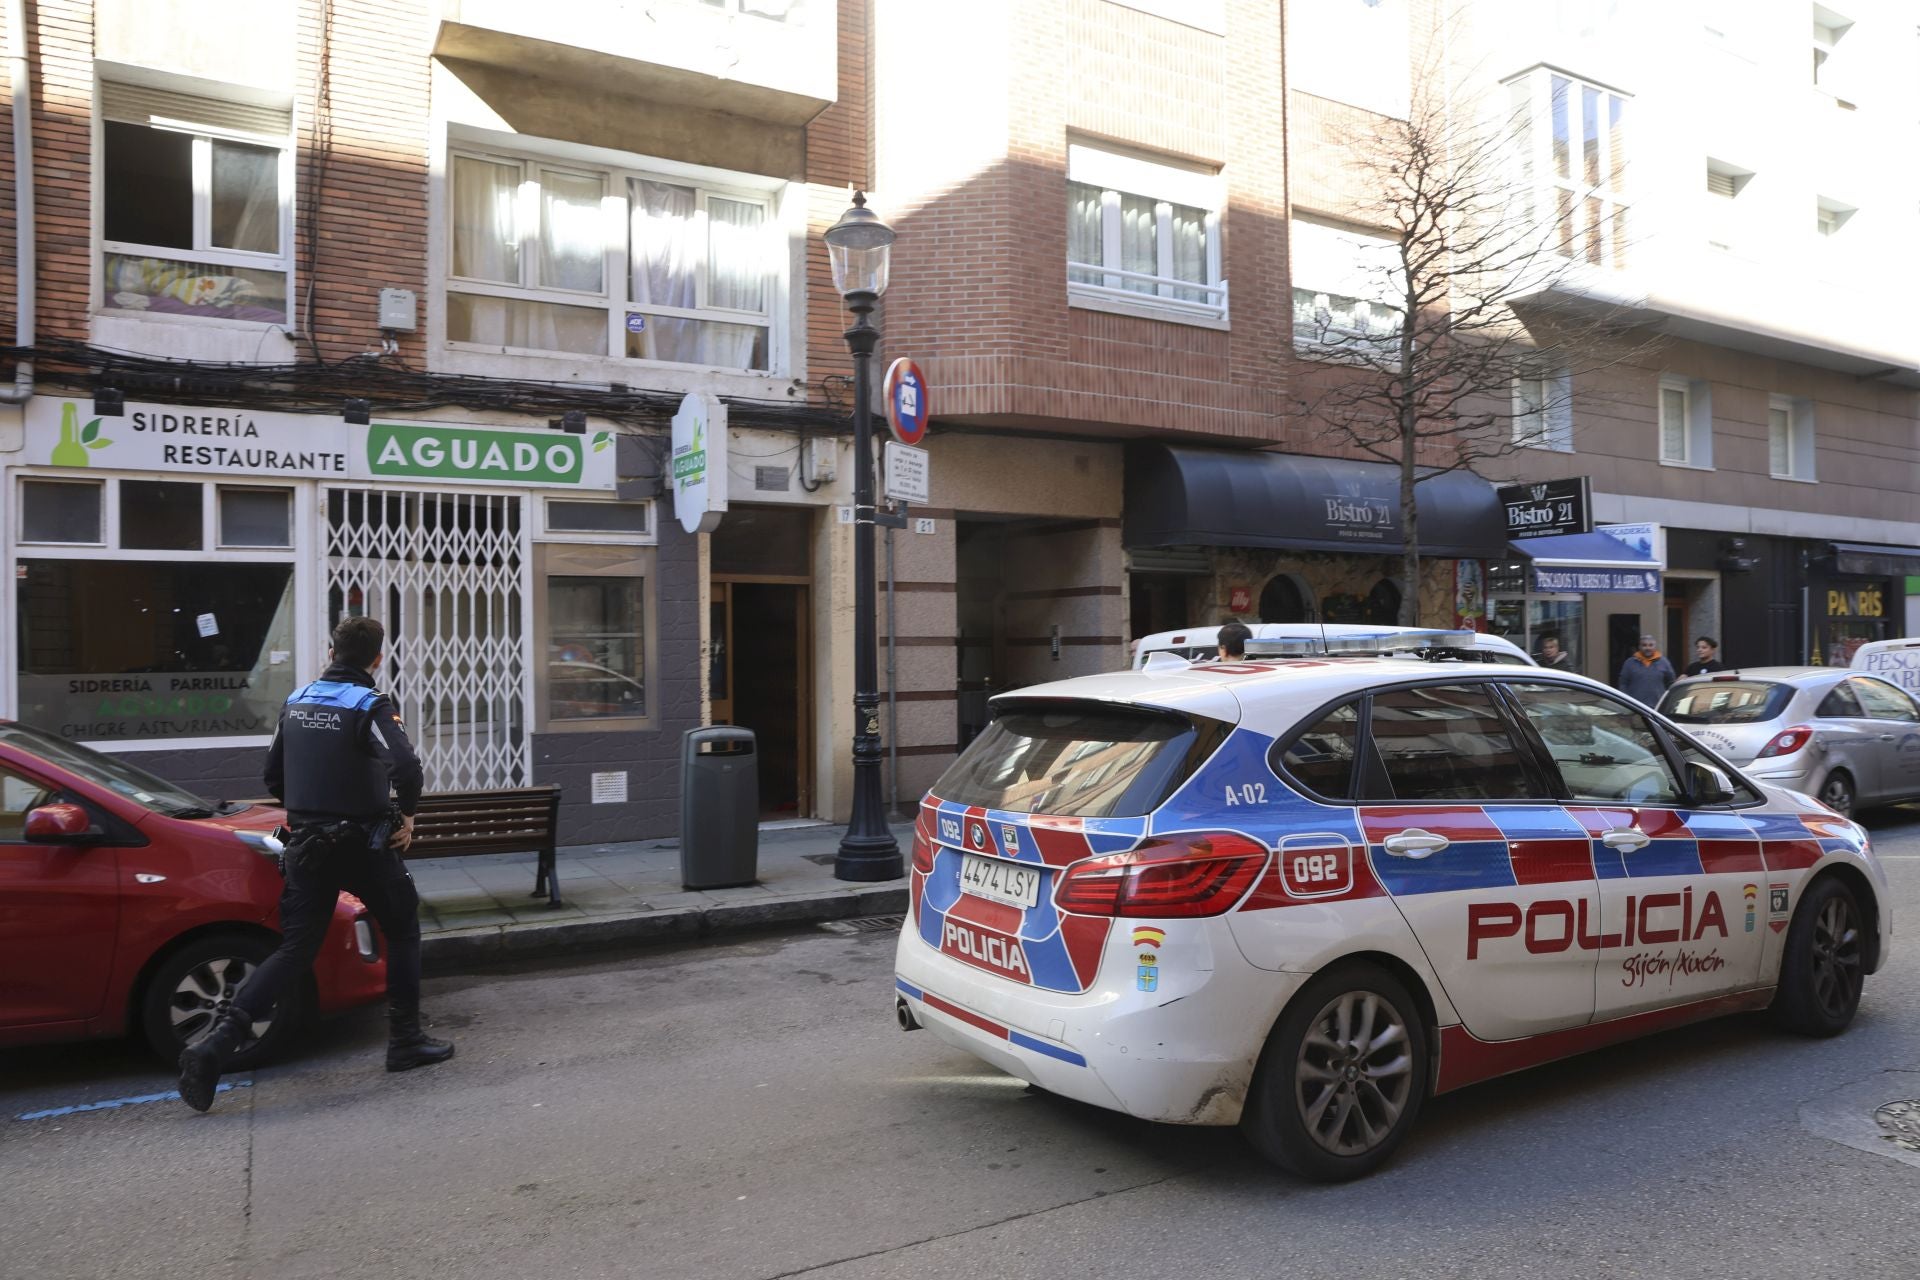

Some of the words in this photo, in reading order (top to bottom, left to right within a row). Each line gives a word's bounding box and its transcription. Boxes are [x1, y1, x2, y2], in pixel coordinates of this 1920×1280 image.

[133, 412, 259, 438] SIDRERÍA
[164, 444, 345, 471] RESTAURANTE
[376, 435, 576, 474] AGUADO
[1326, 499, 1373, 523] Bistró
[1508, 502, 1554, 526] Bistró
[1558, 502, 1574, 521] 21
[1866, 651, 1920, 671] PESC
[69, 675, 153, 694] SIDRERÍA
[170, 677, 250, 691] PARRILLA
[96, 695, 232, 717] AGUADO
[61, 722, 128, 738] CHIGRE
[302, 721, 340, 730] LOCAL
[1225, 783, 1268, 806] A-02
[941, 818, 961, 841] 092
[964, 858, 999, 891] 4474
[1004, 868, 1035, 900] LSY
[1294, 854, 1338, 883] 092
[1467, 885, 1729, 960] POLICÍA
[945, 922, 1027, 975] POLICÍA
